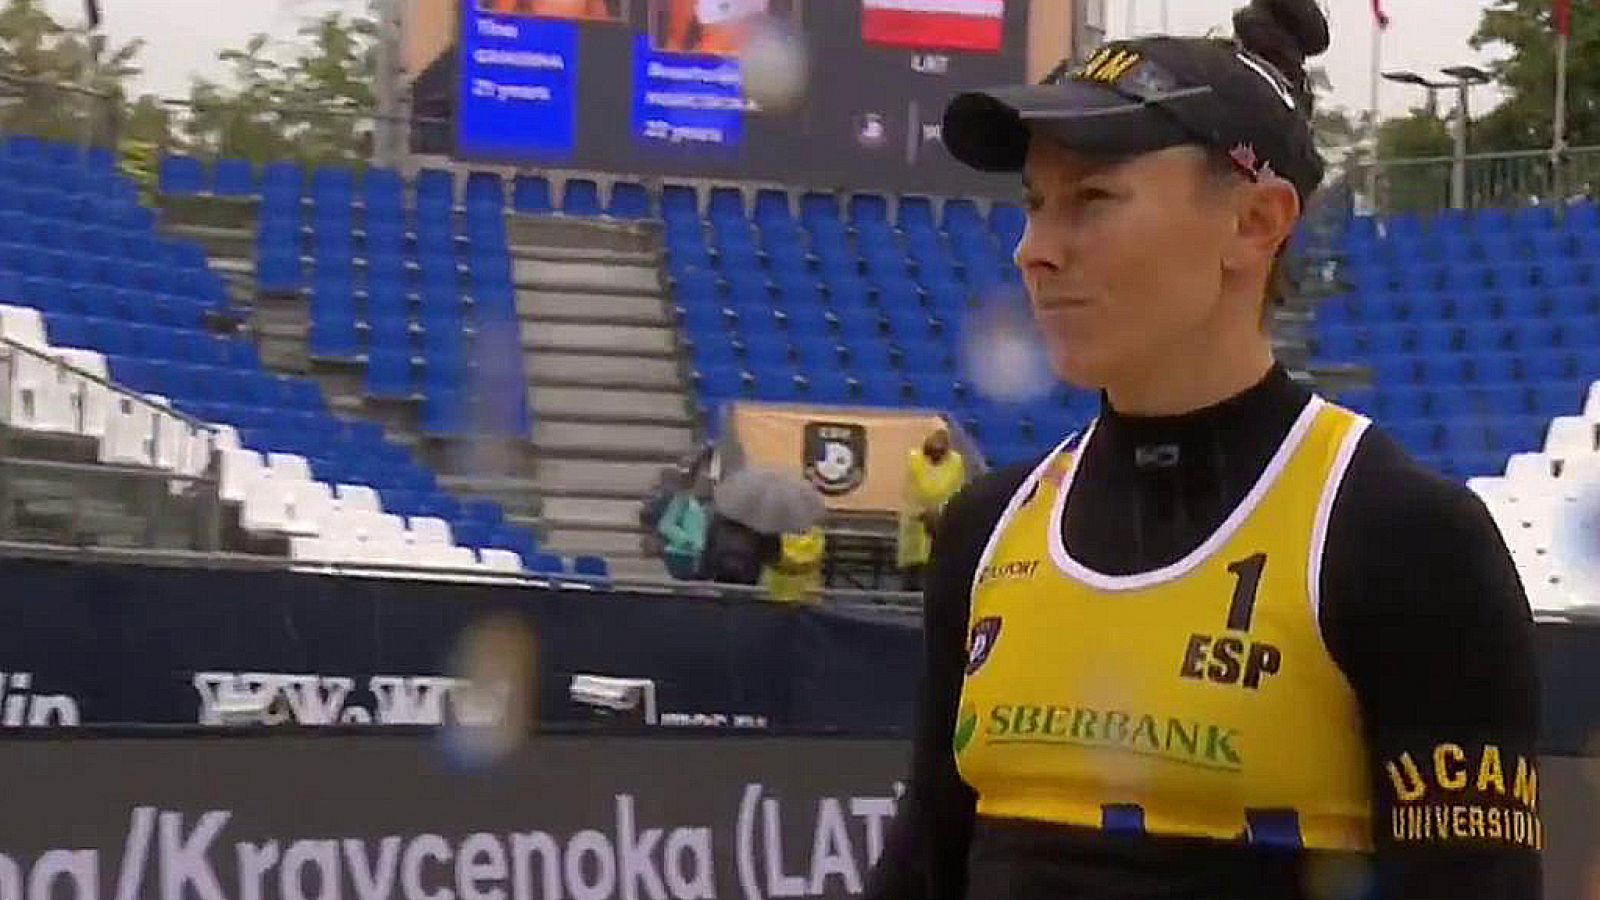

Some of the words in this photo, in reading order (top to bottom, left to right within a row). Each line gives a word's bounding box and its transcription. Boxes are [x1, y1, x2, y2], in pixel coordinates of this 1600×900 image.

[1227, 553, 1267, 632] 1
[1180, 633, 1281, 690] ESP
[985, 703, 1243, 763] SBERBANK
[736, 783, 905, 900] (LAT
